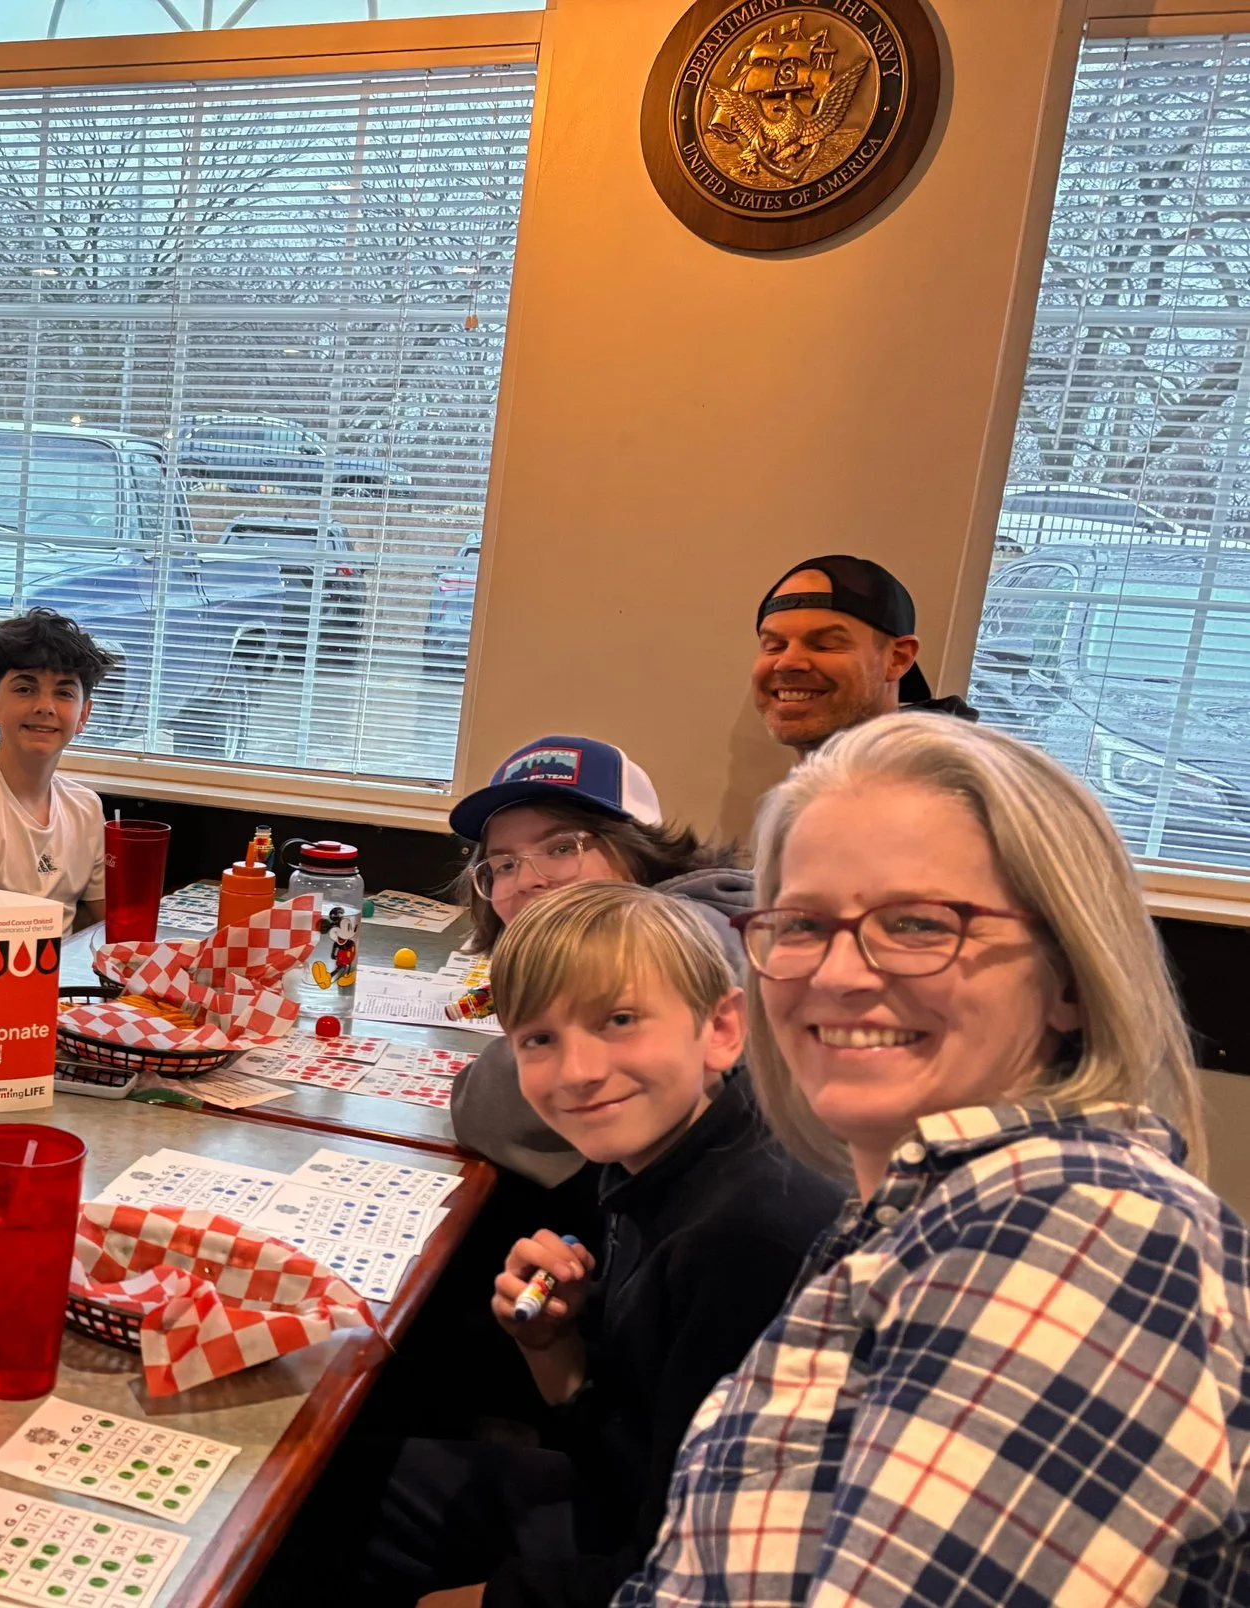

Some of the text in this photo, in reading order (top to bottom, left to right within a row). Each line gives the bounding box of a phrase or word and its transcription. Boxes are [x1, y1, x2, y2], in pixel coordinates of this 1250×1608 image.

[867, 23, 901, 78] NAVY
[682, 137, 882, 209] UNITED STATES OF AMERICA
[63, 1514, 79, 1525] 74
